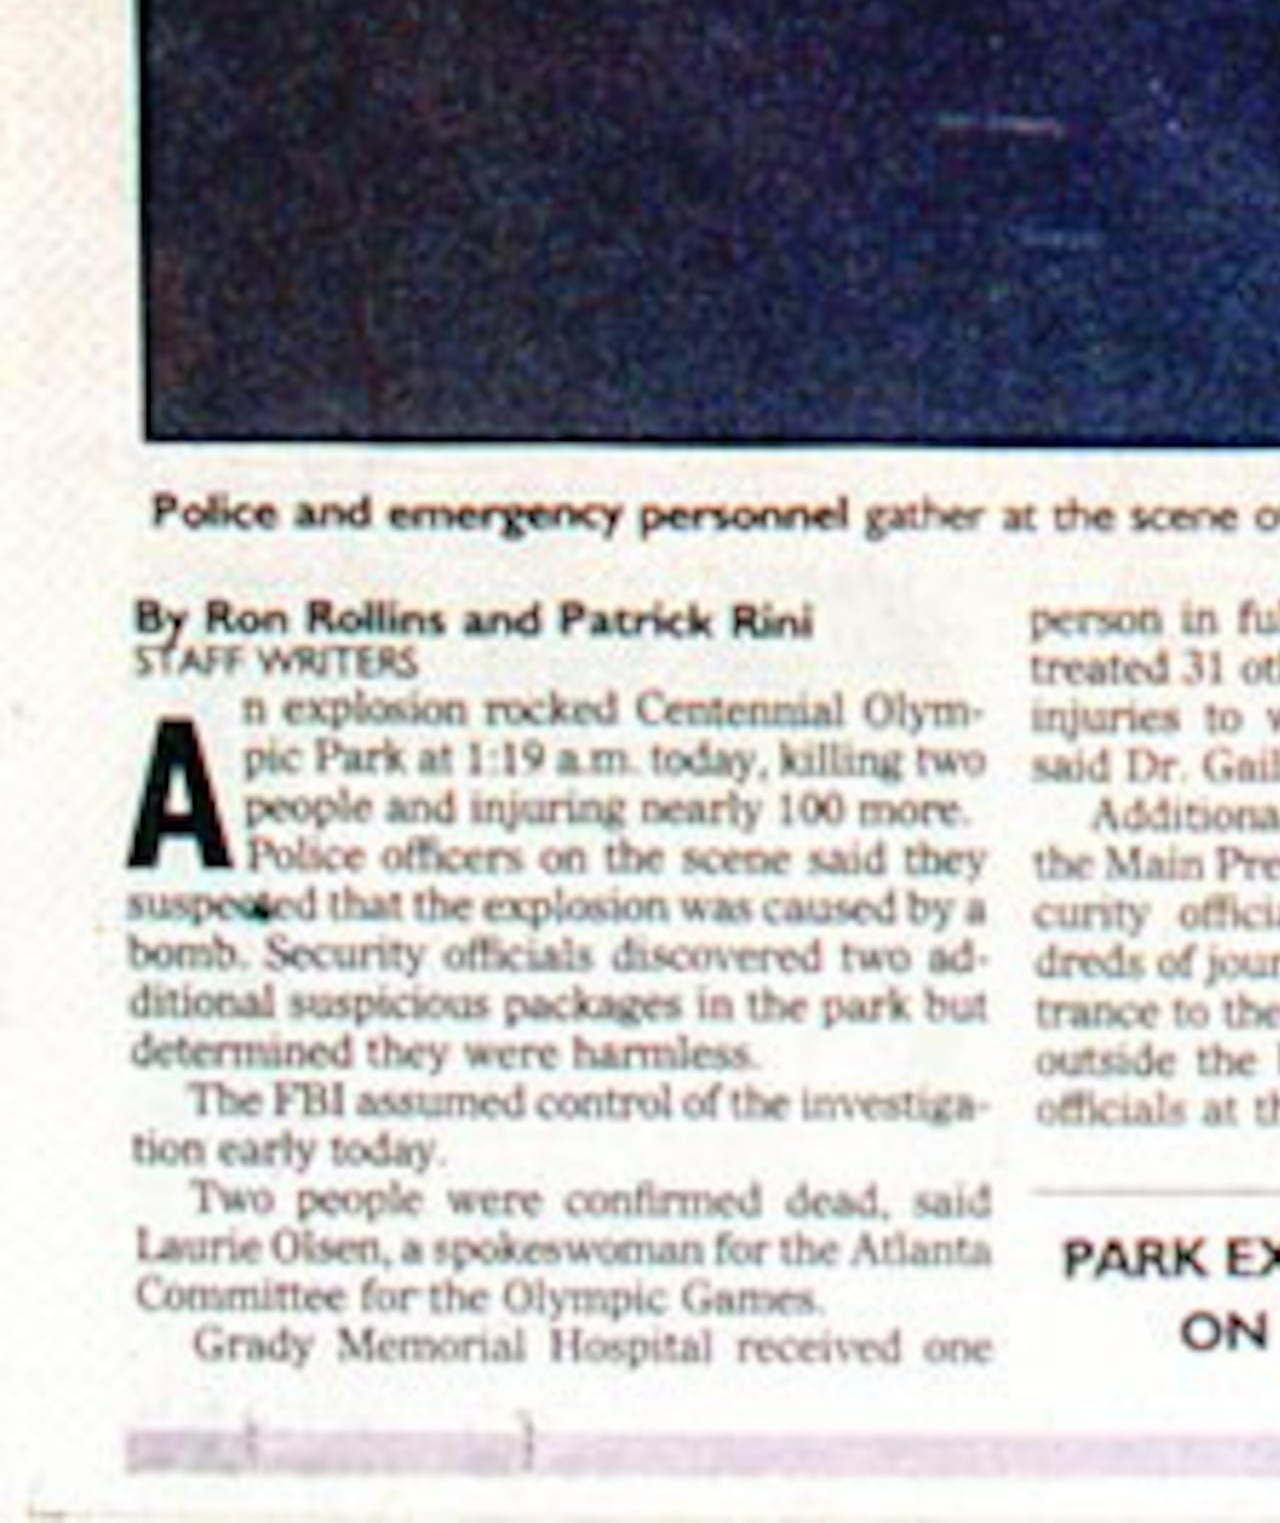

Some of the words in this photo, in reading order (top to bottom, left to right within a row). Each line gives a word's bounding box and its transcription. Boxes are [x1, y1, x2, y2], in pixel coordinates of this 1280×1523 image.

[153, 493, 277, 530] Police
[295, 495, 372, 529] and
[388, 504, 623, 540] emergency
[640, 496, 848, 540] personnel
[866, 500, 983, 541] gather
[1003, 505, 1036, 532] at
[1053, 498, 1116, 532] the
[1130, 505, 1238, 533] scene
[135, 599, 195, 655] By
[206, 599, 288, 635] Ron
[306, 599, 446, 636] Rollins
[464, 602, 542, 637] and
[560, 600, 711, 639] Patrick
[732, 604, 813, 639] Rini
[136, 647, 241, 676] STAFF
[258, 647, 418, 677] WRITERS
[282, 688, 468, 731] explosion
[484, 690, 618, 726] rocked
[635, 688, 844, 729] Centennial
[863, 692, 981, 731] Olym-
[1064, 1237, 1207, 1278] PARK
[1181, 1310, 1267, 1351] ON
